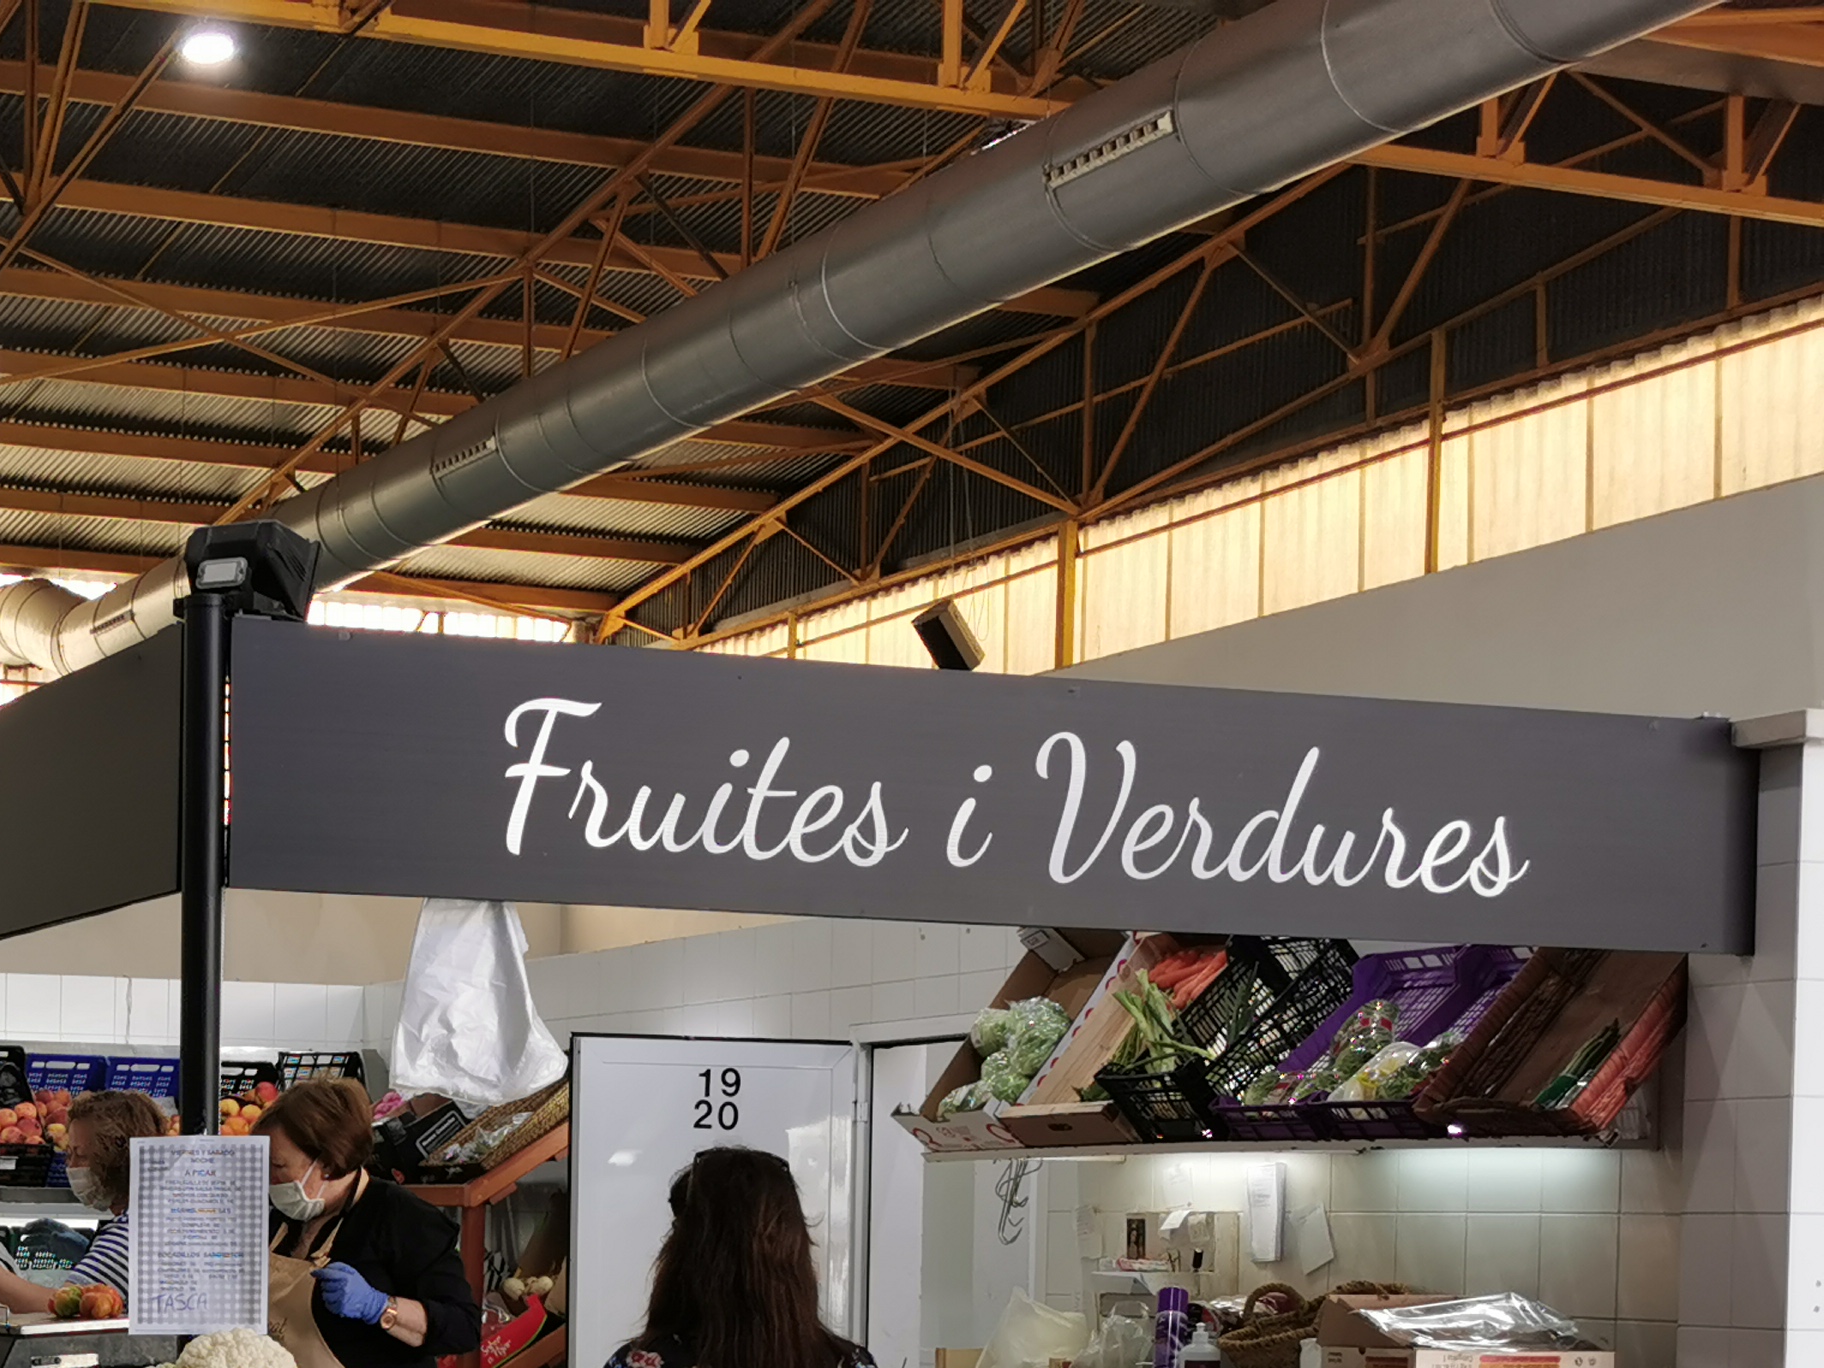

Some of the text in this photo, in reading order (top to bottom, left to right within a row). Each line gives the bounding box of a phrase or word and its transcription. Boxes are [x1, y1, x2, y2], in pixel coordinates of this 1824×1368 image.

[505, 698, 1530, 897] Fruites i Verdures
[698, 1067, 742, 1098] 19
[693, 1099, 739, 1131] 20
[150, 1292, 209, 1314] TASCA
